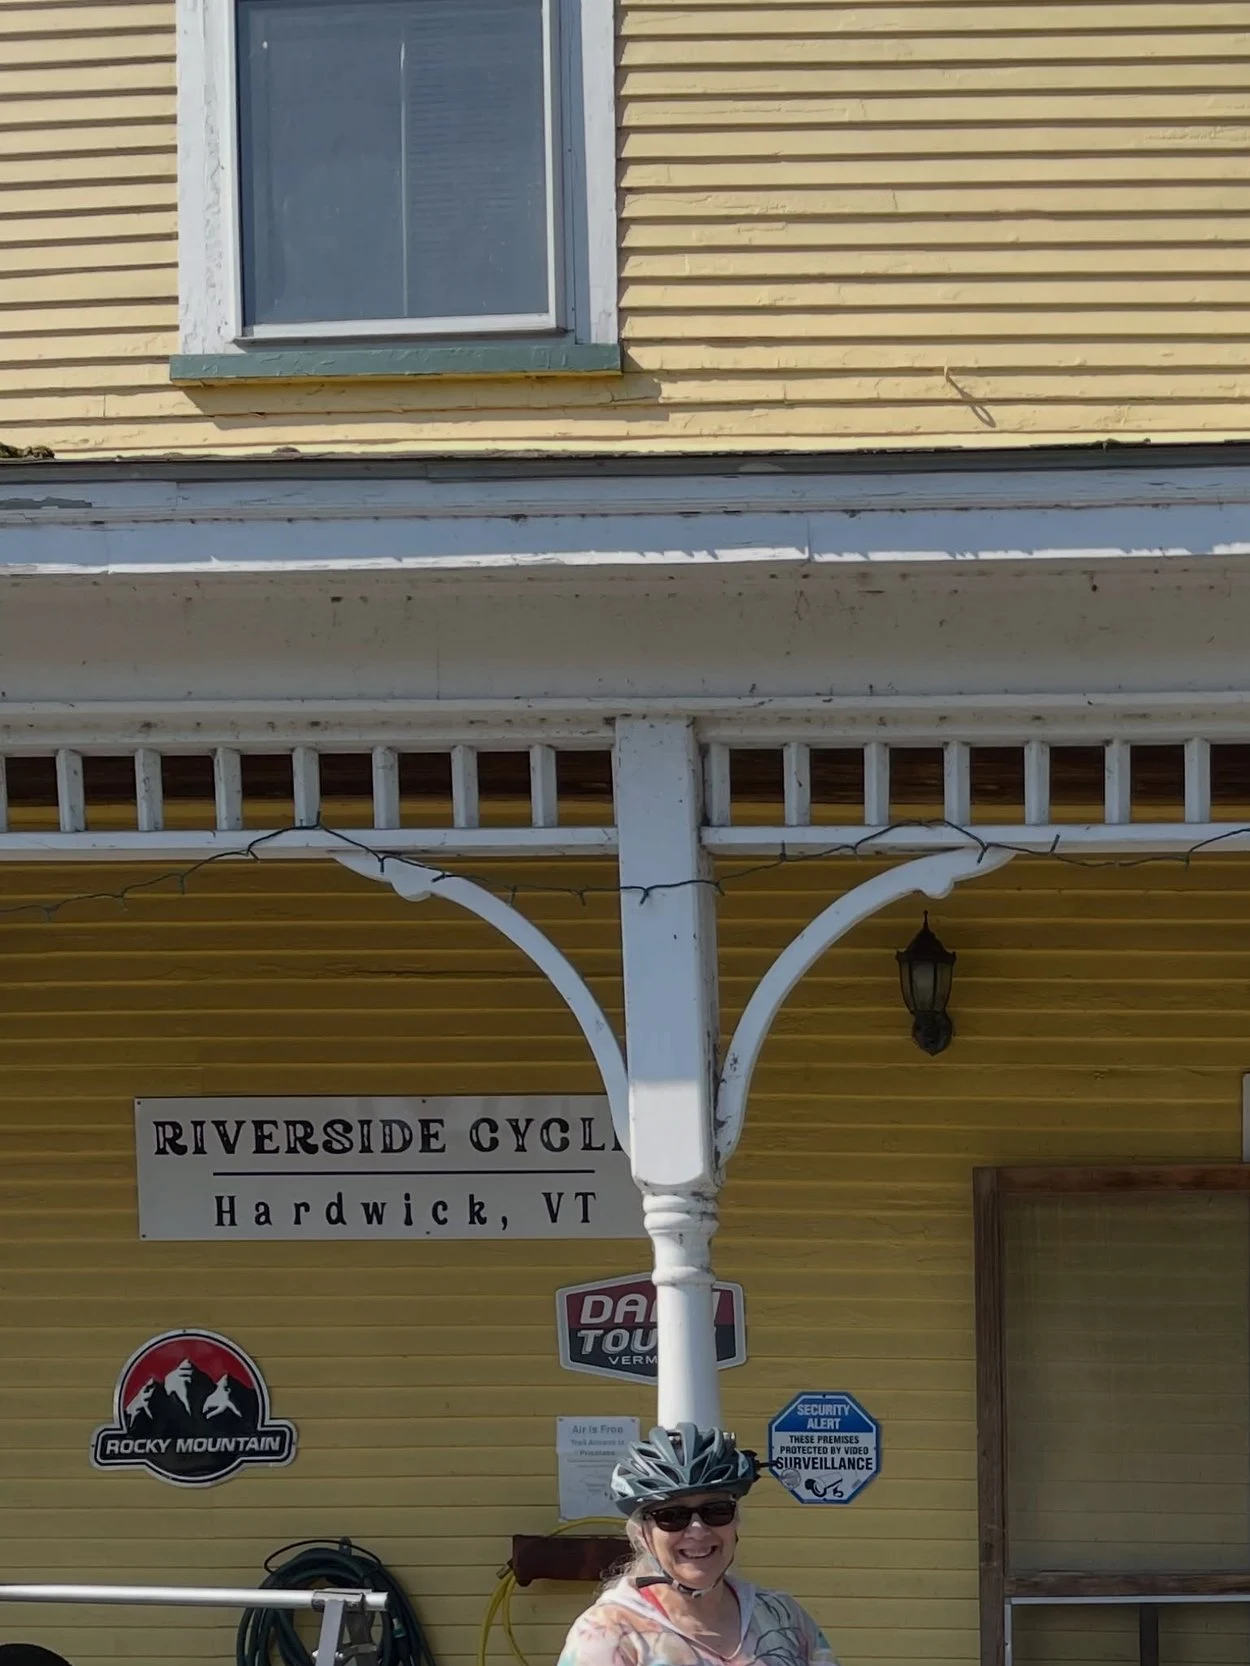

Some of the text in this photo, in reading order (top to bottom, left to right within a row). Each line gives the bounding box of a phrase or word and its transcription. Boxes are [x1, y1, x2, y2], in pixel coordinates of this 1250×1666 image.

[153, 1117, 447, 1156] RIVERSIDE
[215, 1192, 597, 1231] Hardwick, VT
[797, 1404, 850, 1416] SECURITY
[807, 1418, 841, 1430] ALERT
[106, 1436, 281, 1454] ROCKY MOUNTAIN
[789, 1435, 860, 1444] THESE PREMISES
[780, 1446, 869, 1455] PROTECTED BY VIDEO
[775, 1456, 872, 1470] SURVEILLANCE
